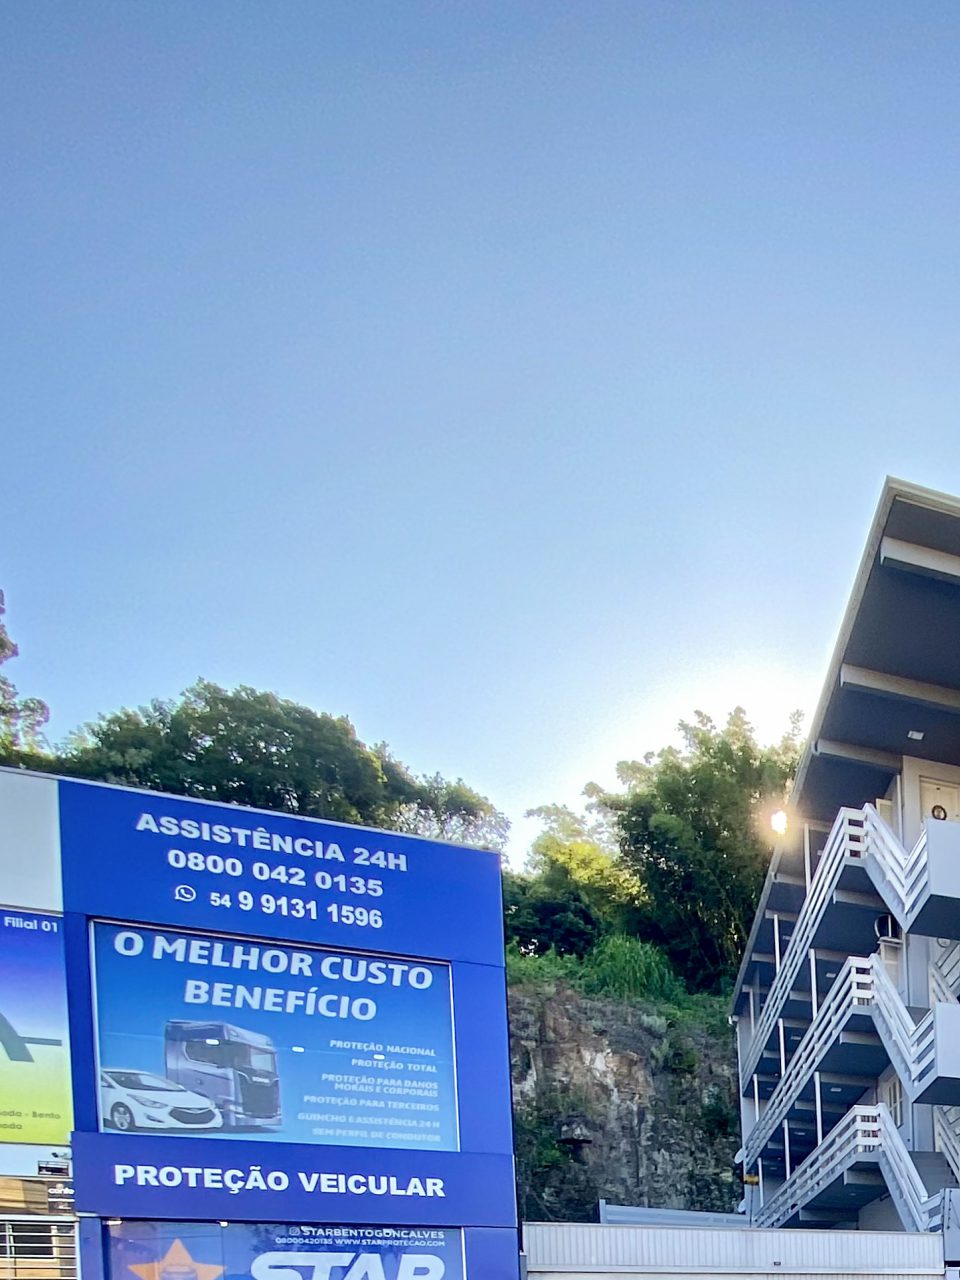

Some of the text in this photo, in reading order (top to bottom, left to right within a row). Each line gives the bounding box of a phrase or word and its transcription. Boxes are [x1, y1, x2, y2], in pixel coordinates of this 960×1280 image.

[136, 813, 408, 871] ASSISTÊNCIA 24H
[167, 850, 383, 897] 0800 042 0135
[210, 891, 383, 928] 54 9 9131 1596
[4, 916, 58, 933] Filial 01
[113, 931, 433, 989] O MELHOR CUSTO
[183, 979, 377, 1021] BENEFÍCIO
[330, 1040, 436, 1057] PROTEÇÃO NACIONAL
[352, 1059, 437, 1073] PROTEÇÃO TOTAL
[321, 1073, 438, 1089] PROTEÇÃO PARA DANOS
[384, 1087, 438, 1097] CORPORAIS
[304, 1096, 439, 1112] PROTEÇÃO PARA TERCEIROS
[114, 1164, 446, 1197] PROTEÇÃO VEICULAR
[303, 1227, 445, 1239] STARBENTOGONCALVES
